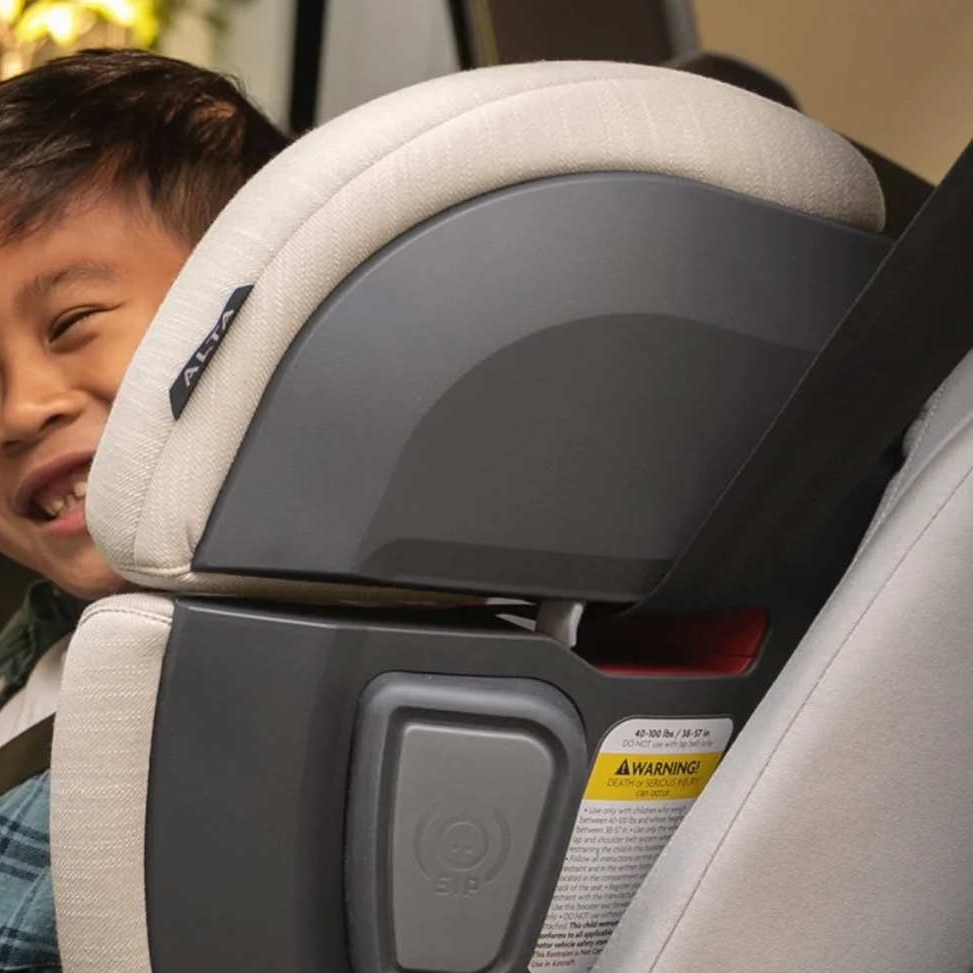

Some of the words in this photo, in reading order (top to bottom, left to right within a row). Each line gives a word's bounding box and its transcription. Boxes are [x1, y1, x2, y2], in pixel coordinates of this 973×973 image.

[184, 309, 235, 387] ALTA
[635, 729, 662, 738] 40-100
[663, 729, 674, 738] lbs
[682, 729, 702, 738] 38-57
[703, 728, 711, 737] in
[622, 740, 634, 748] DO
[635, 740, 651, 748] NOT
[664, 740, 678, 748] with
[688, 740, 700, 748] belt
[701, 740, 713, 749] only
[632, 761, 702, 776] WARNING!
[607, 778, 634, 788] DEATH
[636, 780, 644, 788] or
[645, 778, 676, 787] SERIOUS
[677, 777, 700, 787] INJURY
[636, 790, 649, 798] can
[602, 808, 616, 816] only
[580, 816, 606, 824] between
[576, 826, 604, 834] between
[572, 836, 582, 844] lap
[433, 874, 480, 898] SIP
[577, 940, 595, 949] safety
[547, 950, 573, 958] Restraint
[531, 960, 543, 968] Use
